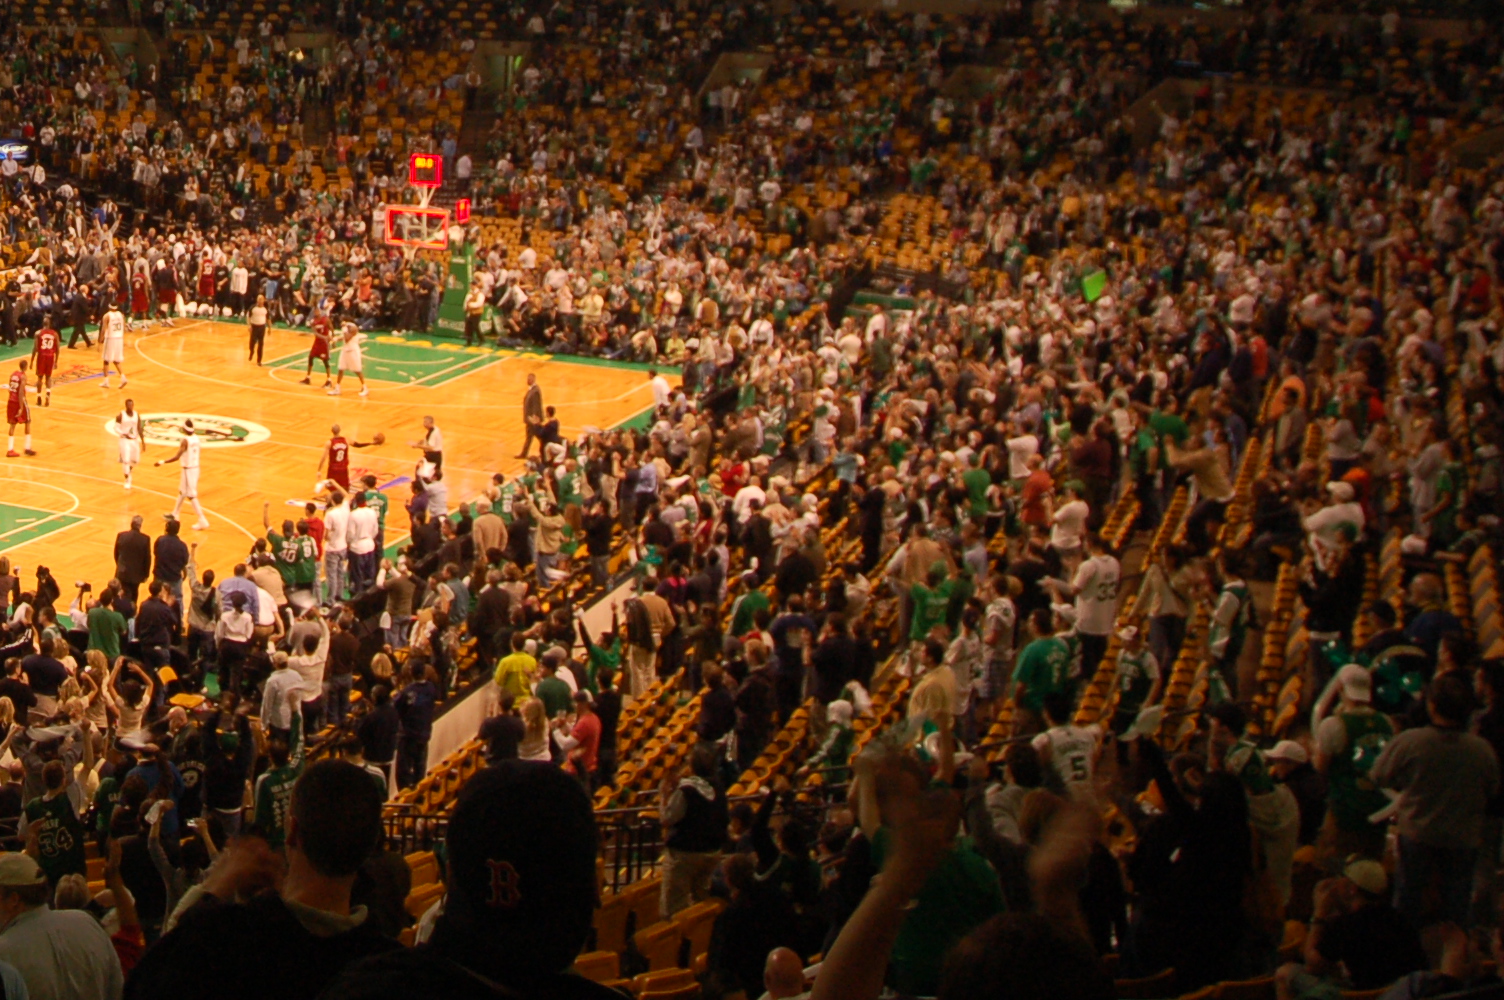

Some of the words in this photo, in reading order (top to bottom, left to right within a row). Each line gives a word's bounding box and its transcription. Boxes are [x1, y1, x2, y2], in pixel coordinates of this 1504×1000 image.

[335, 449, 344, 462] 8
[1071, 755, 1088, 781] 5
[37, 829, 74, 858] 34
[485, 858, 522, 909] B
